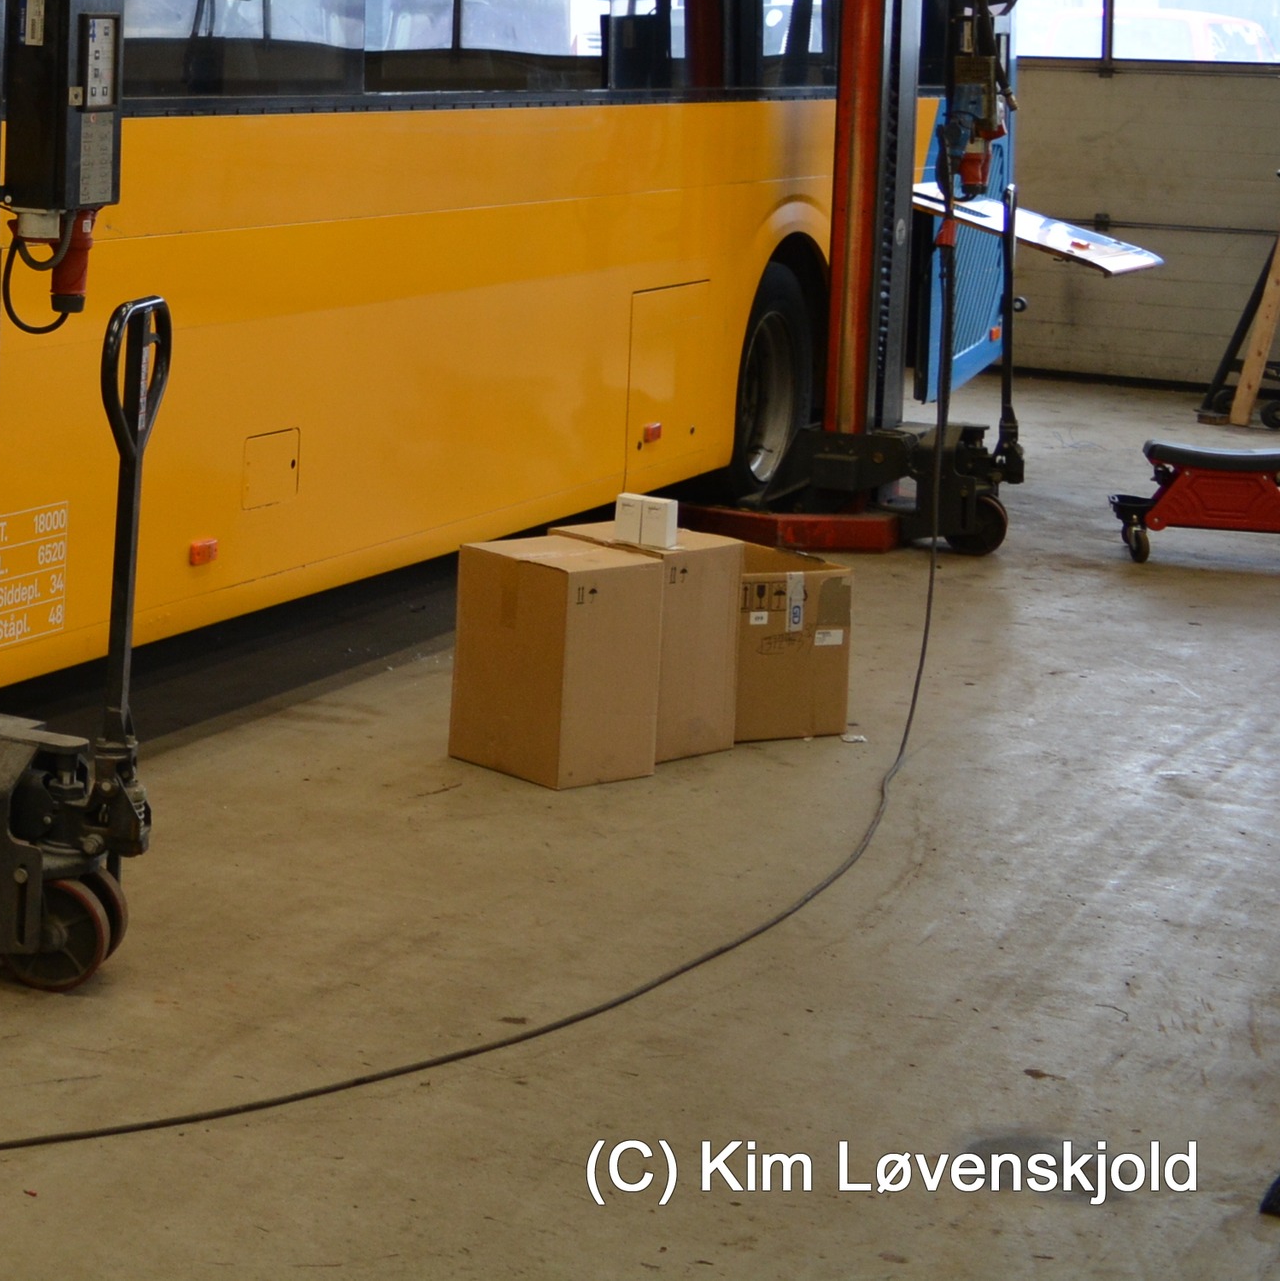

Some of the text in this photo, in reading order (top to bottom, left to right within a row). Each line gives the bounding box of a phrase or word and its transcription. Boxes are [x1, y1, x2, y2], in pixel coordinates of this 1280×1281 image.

[33, 509, 67, 534] 18000
[37, 541, 66, 565] 6520
[49, 572, 64, 594] 34
[48, 604, 63, 626] 48
